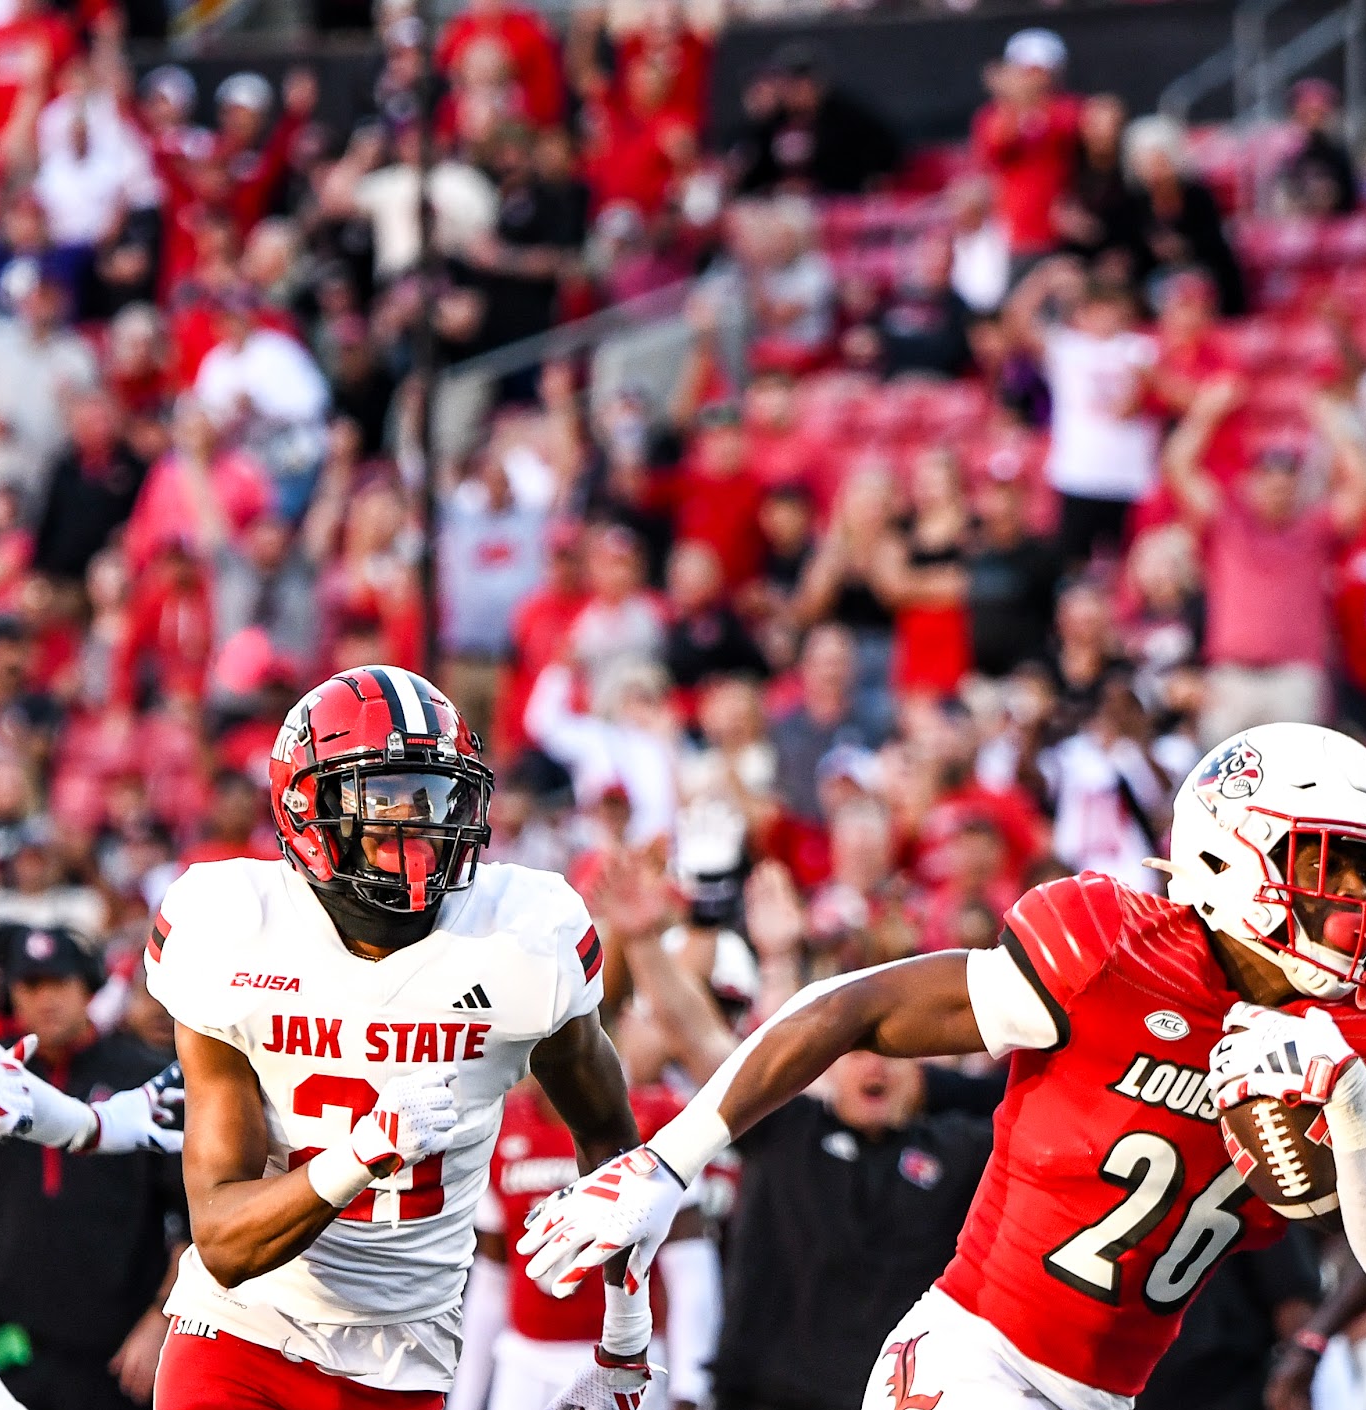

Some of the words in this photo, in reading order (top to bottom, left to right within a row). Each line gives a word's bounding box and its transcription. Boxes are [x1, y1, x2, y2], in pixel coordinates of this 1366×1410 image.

[262, 1014, 343, 1059] JAX
[365, 1022, 492, 1063] STATE
[1153, 1018, 1183, 1032] ACC
[1047, 1132, 1246, 1303] 26
